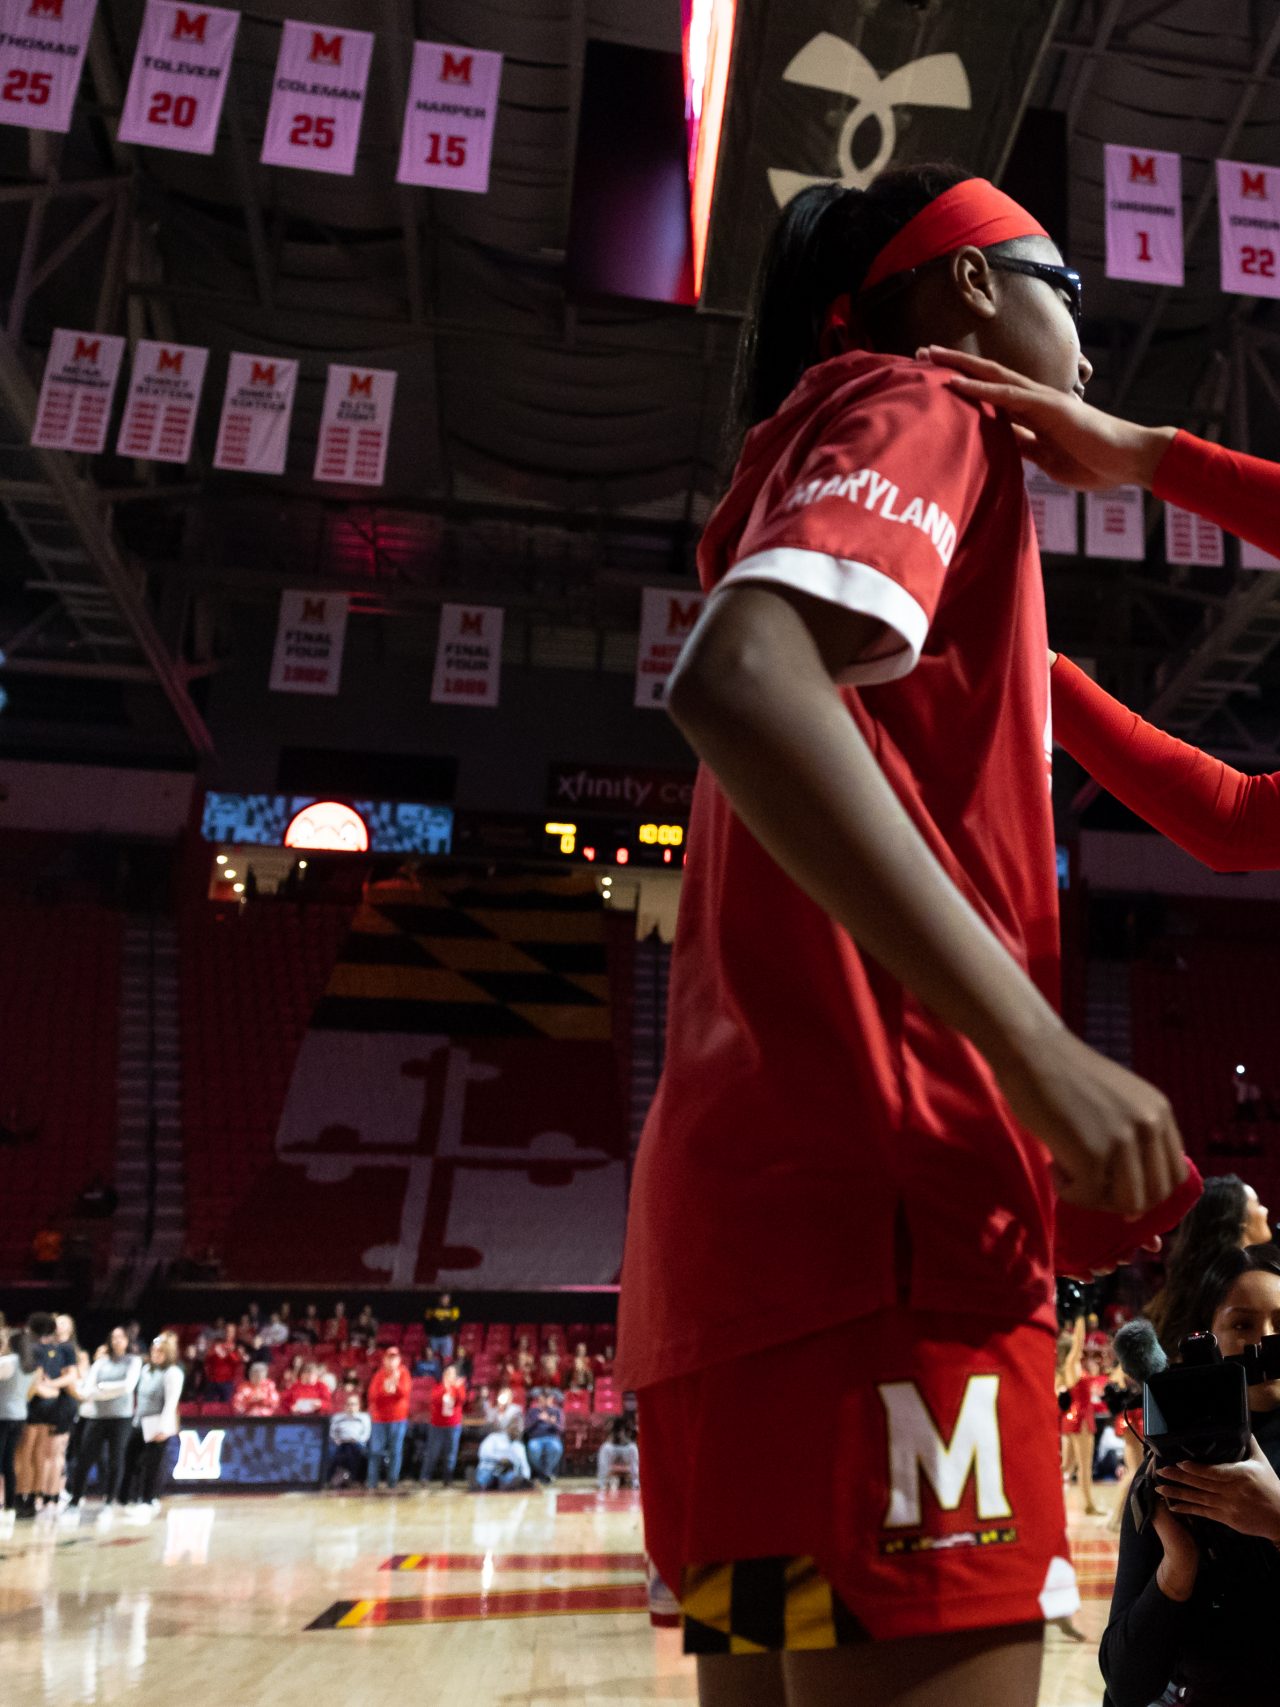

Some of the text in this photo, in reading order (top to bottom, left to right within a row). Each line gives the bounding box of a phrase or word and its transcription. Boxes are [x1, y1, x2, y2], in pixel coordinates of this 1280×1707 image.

[171, 9, 208, 43] M
[1, 33, 79, 56] THOMAS
[309, 32, 343, 66] M
[143, 55, 221, 79] TOLIVER
[440, 52, 473, 85] M
[3, 69, 52, 105] 25
[277, 77, 361, 100] COLEMAN
[148, 91, 198, 128] 20
[415, 100, 486, 119] HARPER
[289, 113, 336, 149] 25
[425, 131, 467, 167] 15
[1128, 154, 1157, 186] M
[1240, 168, 1268, 201] M
[1136, 231, 1152, 262] 1
[1240, 245, 1275, 278] 22
[73, 336, 101, 364] M
[157, 348, 184, 374] M
[250, 360, 276, 386] M
[348, 372, 373, 398] M
[786, 469, 957, 567] MARYLAND
[302, 598, 326, 622] M
[460, 611, 483, 636] M
[286, 629, 331, 645] FINAL
[445, 643, 490, 658] FINAL
[558, 770, 653, 806] xfinity
[172, 1429, 226, 1480] M
[878, 1374, 1012, 1529] M
